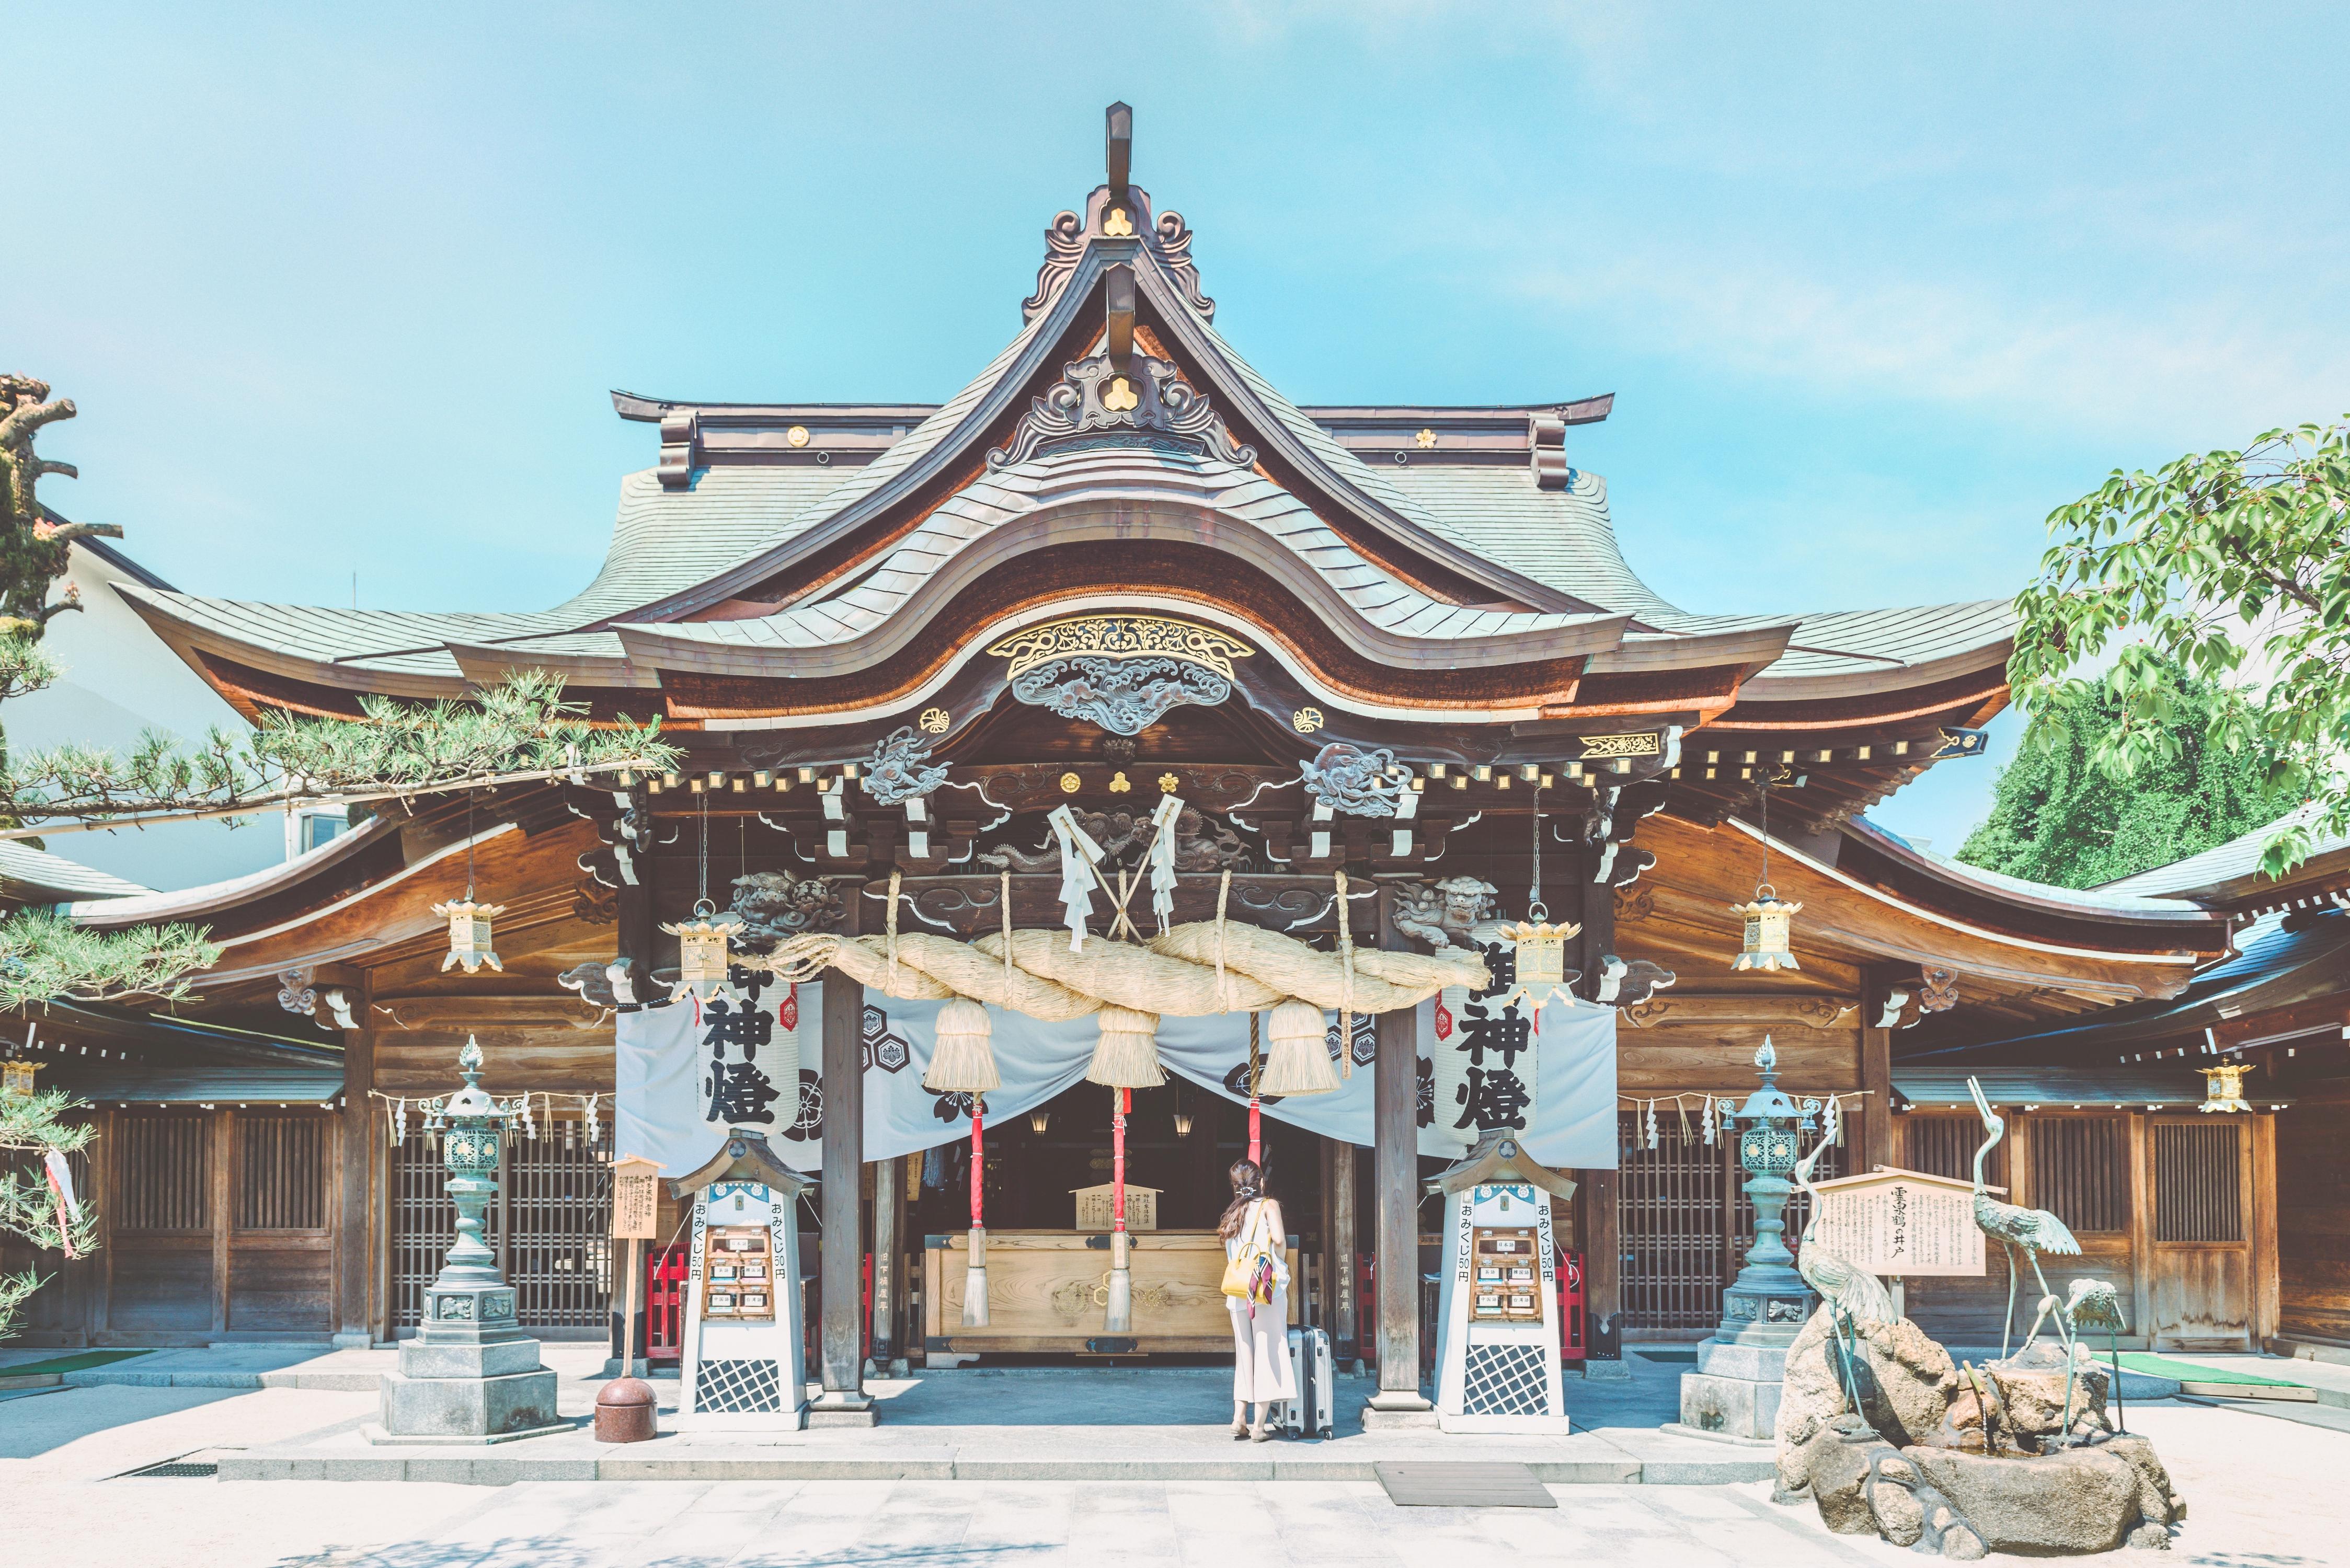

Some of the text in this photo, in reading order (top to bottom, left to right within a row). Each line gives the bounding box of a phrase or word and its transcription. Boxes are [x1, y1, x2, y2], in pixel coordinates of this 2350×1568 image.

[691, 1204, 706, 1280] おみくじ50円
[772, 1203, 785, 1279] おみくじ50円
[1459, 1205, 1472, 1282] おみくじ50円
[1538, 1205, 1553, 1282] おみくじ50円
